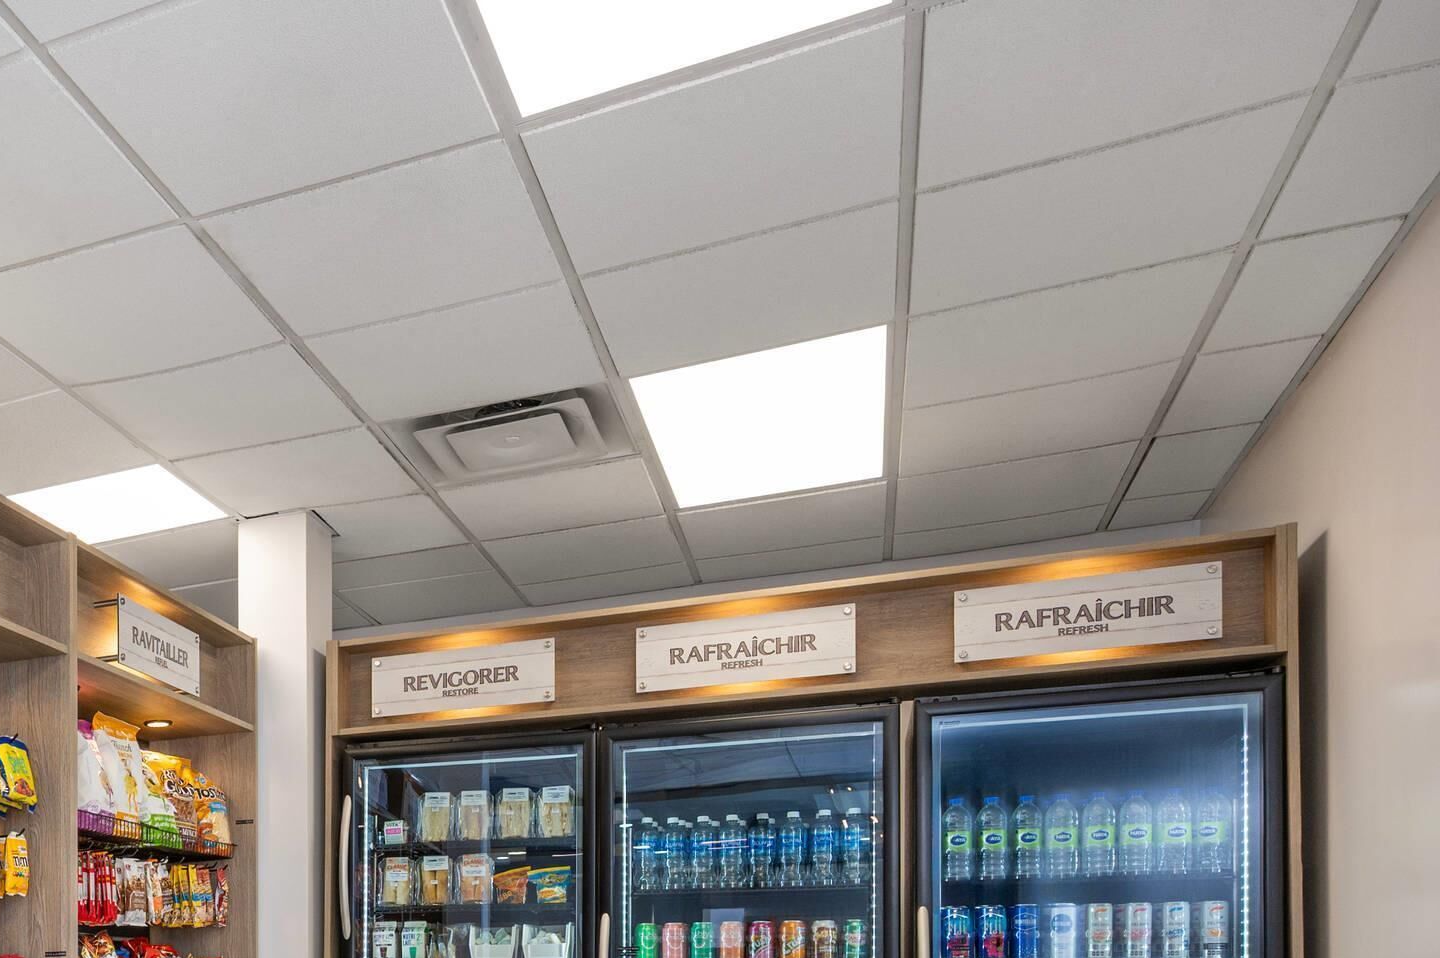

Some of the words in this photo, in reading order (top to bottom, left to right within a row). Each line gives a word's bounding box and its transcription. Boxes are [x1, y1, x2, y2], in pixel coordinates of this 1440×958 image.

[995, 594, 1175, 632] RAFRAÎCHIR
[1057, 623, 1109, 636] REFRESH
[132, 625, 189, 669] RAVITAILLER
[669, 633, 817, 665] RAFRAÎCHIR
[720, 659, 763, 670] REFRESH
[403, 665, 519, 692] REVIGORER
[442, 687, 479, 697] RESTORE
